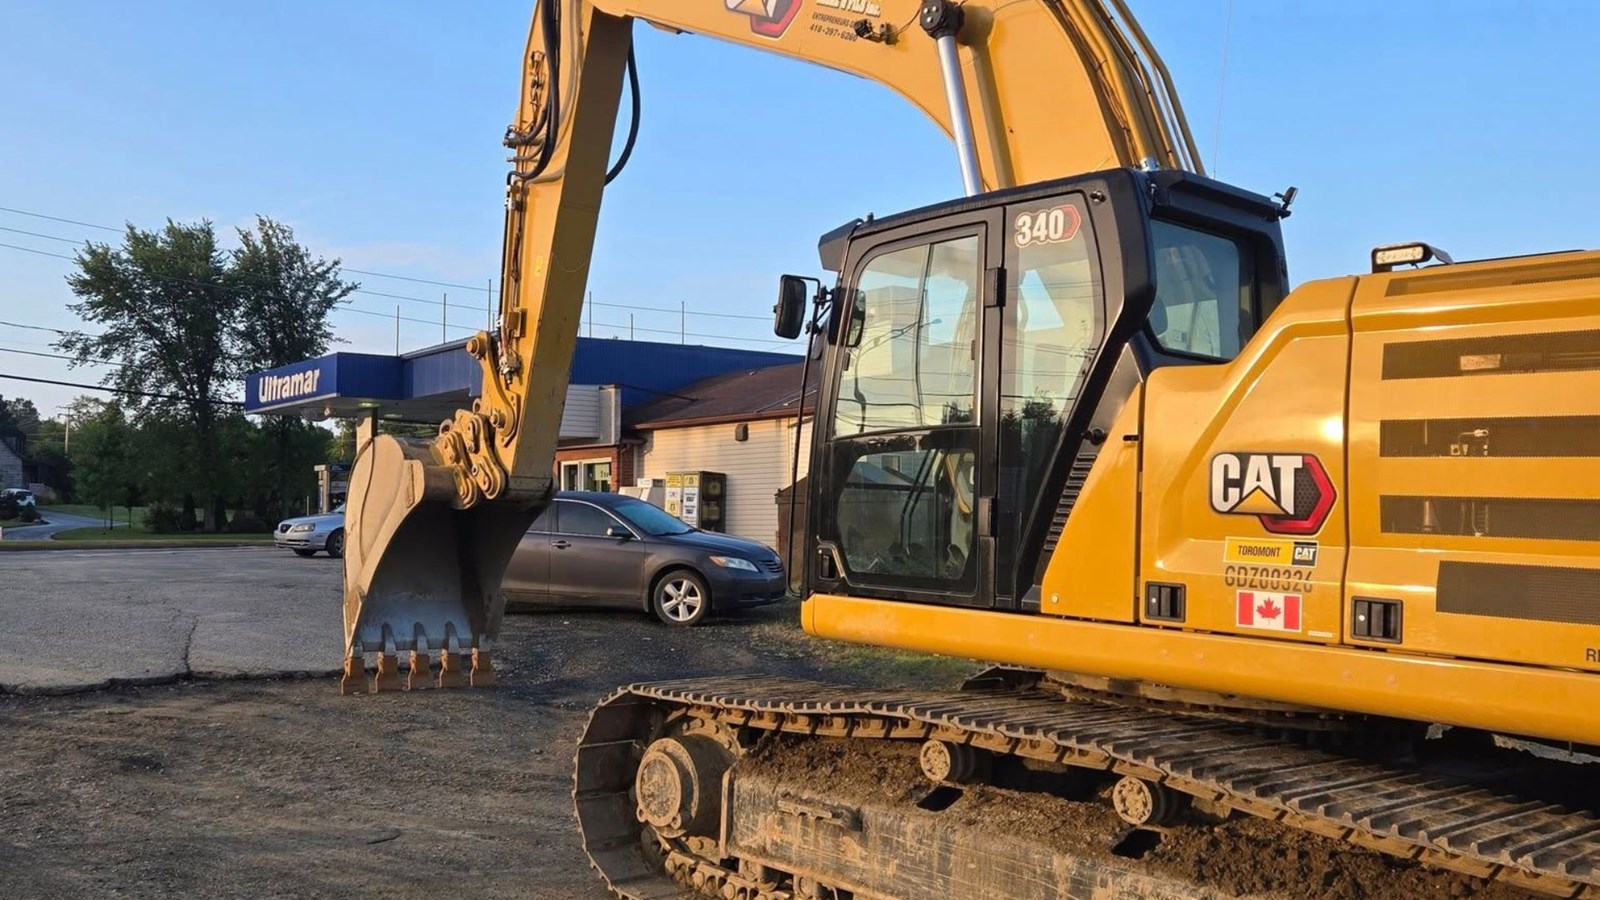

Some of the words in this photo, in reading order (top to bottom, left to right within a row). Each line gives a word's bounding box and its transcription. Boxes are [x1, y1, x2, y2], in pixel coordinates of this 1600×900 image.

[1017, 208, 1065, 245] 340
[258, 368, 321, 403] Ultramar
[1211, 453, 1303, 515] CAT
[1238, 545, 1281, 558] TOROMONT
[1294, 546, 1316, 560] CAT
